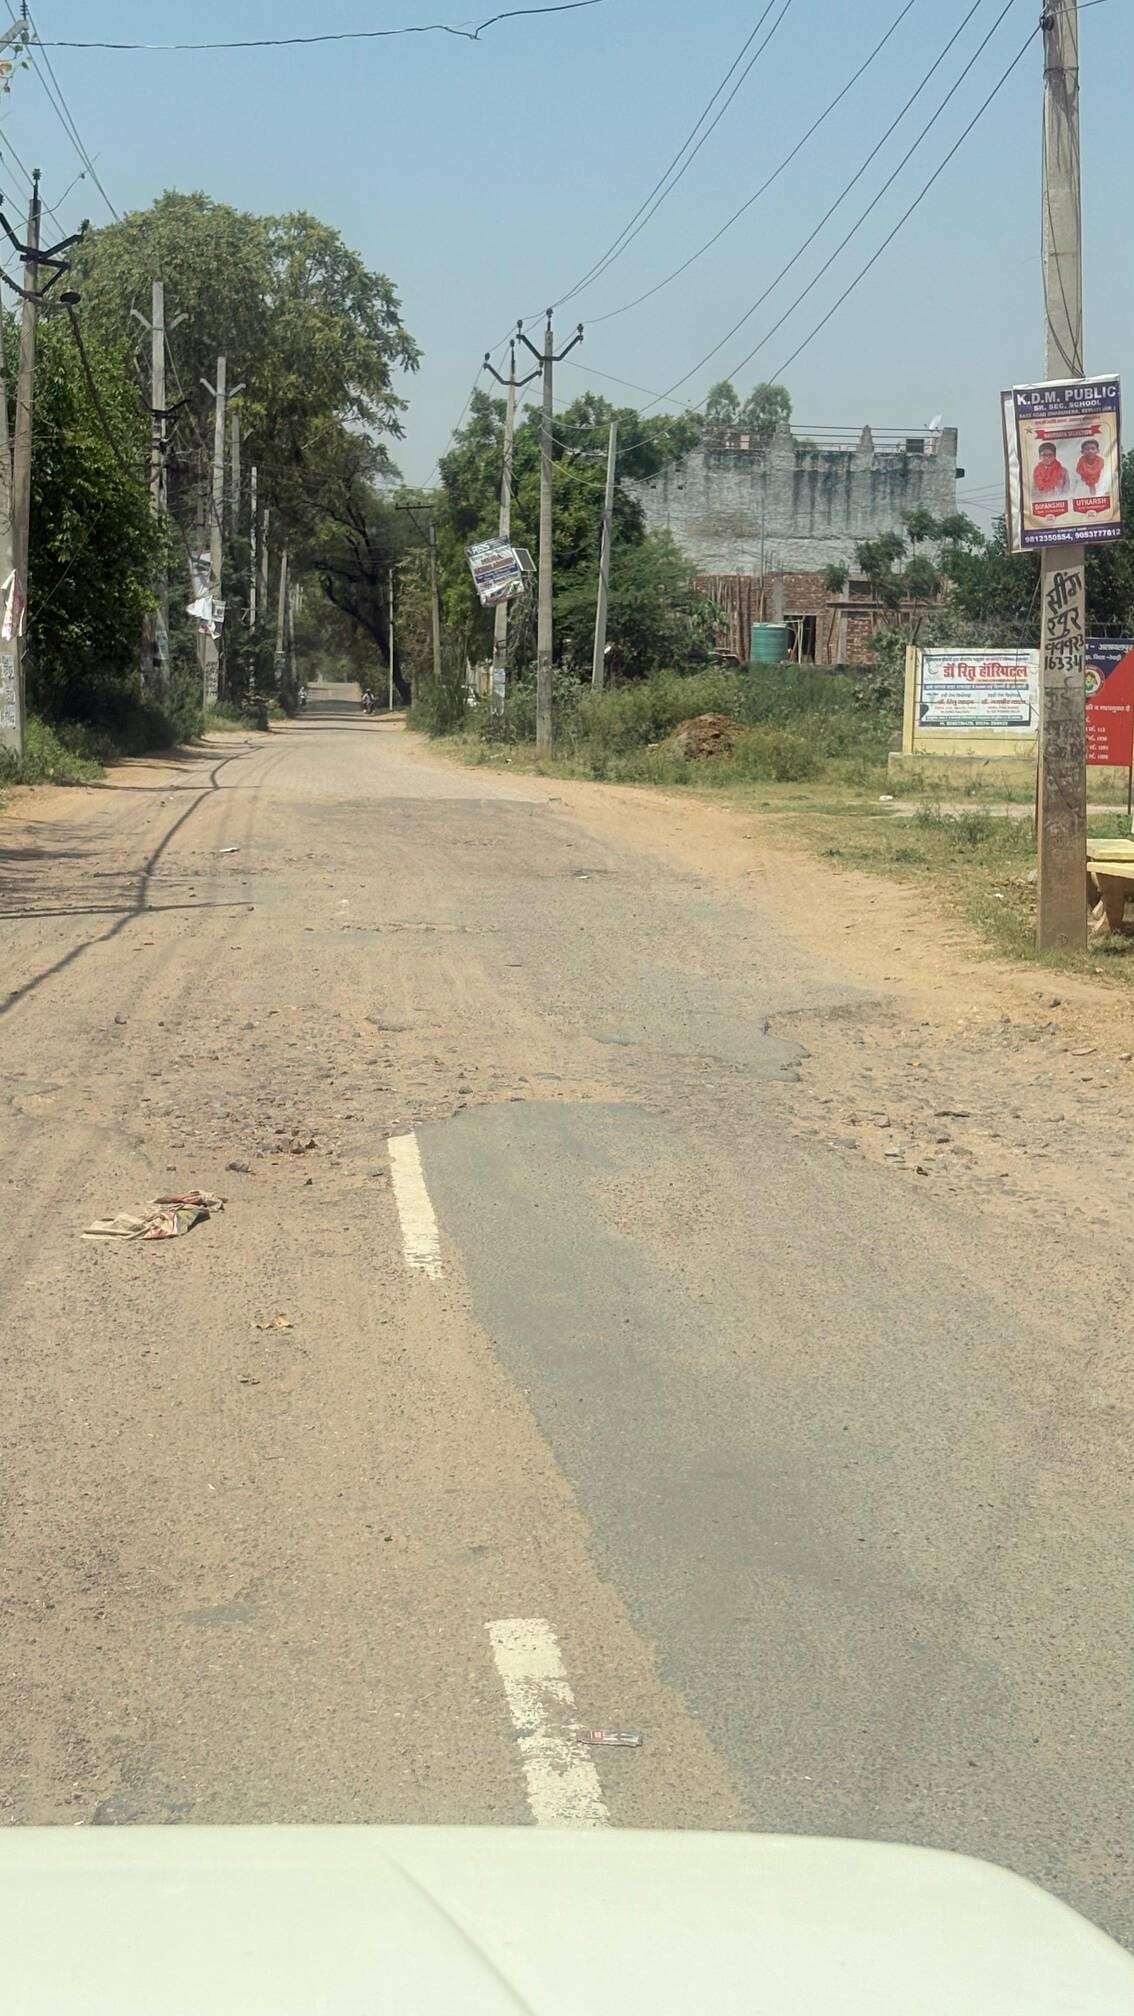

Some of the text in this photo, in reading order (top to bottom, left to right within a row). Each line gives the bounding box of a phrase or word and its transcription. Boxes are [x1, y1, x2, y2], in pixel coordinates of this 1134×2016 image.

[1016, 385, 1117, 406] K.D.M. PUBLIC
[1033, 399, 1102, 412] SR. SEC. SCHOOL
[1076, 497, 1107, 507] UTKARSH
[957, 662, 977, 682] रितु
